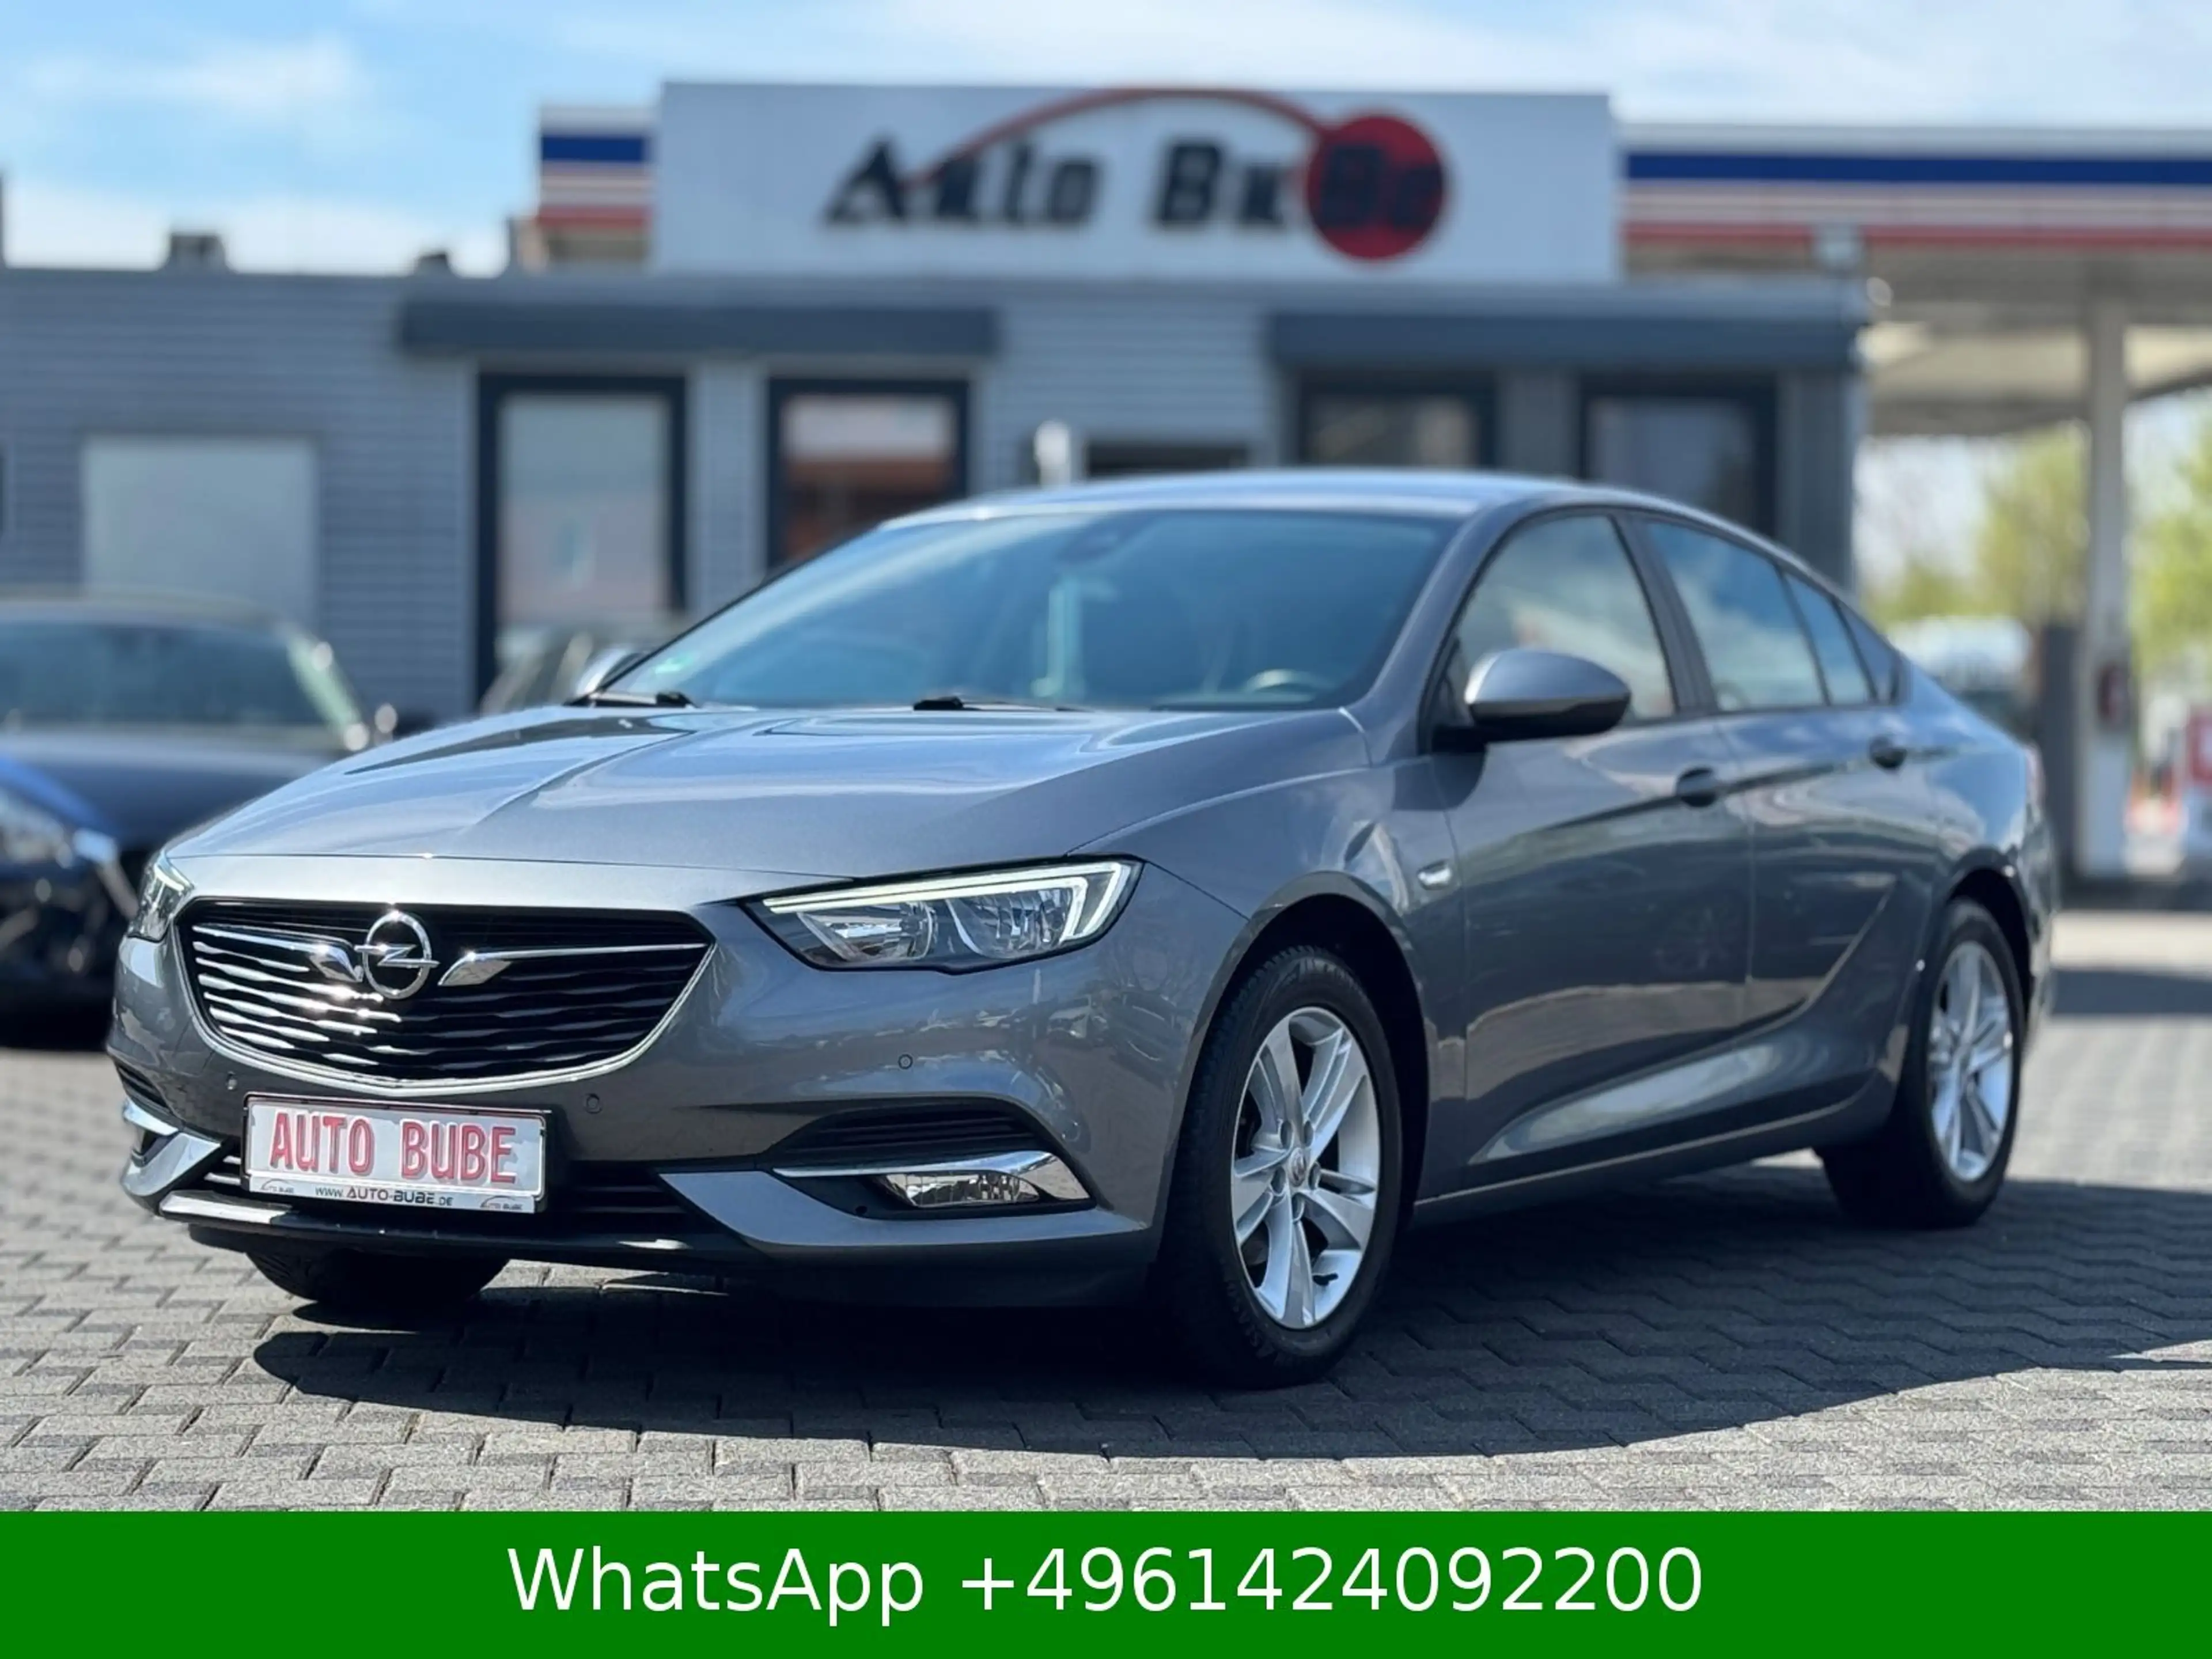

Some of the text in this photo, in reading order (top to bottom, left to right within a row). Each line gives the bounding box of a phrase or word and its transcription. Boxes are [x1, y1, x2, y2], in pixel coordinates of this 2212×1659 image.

[820, 136, 1103, 229] Auto
[269, 1111, 516, 1185] AUTO BUBE
